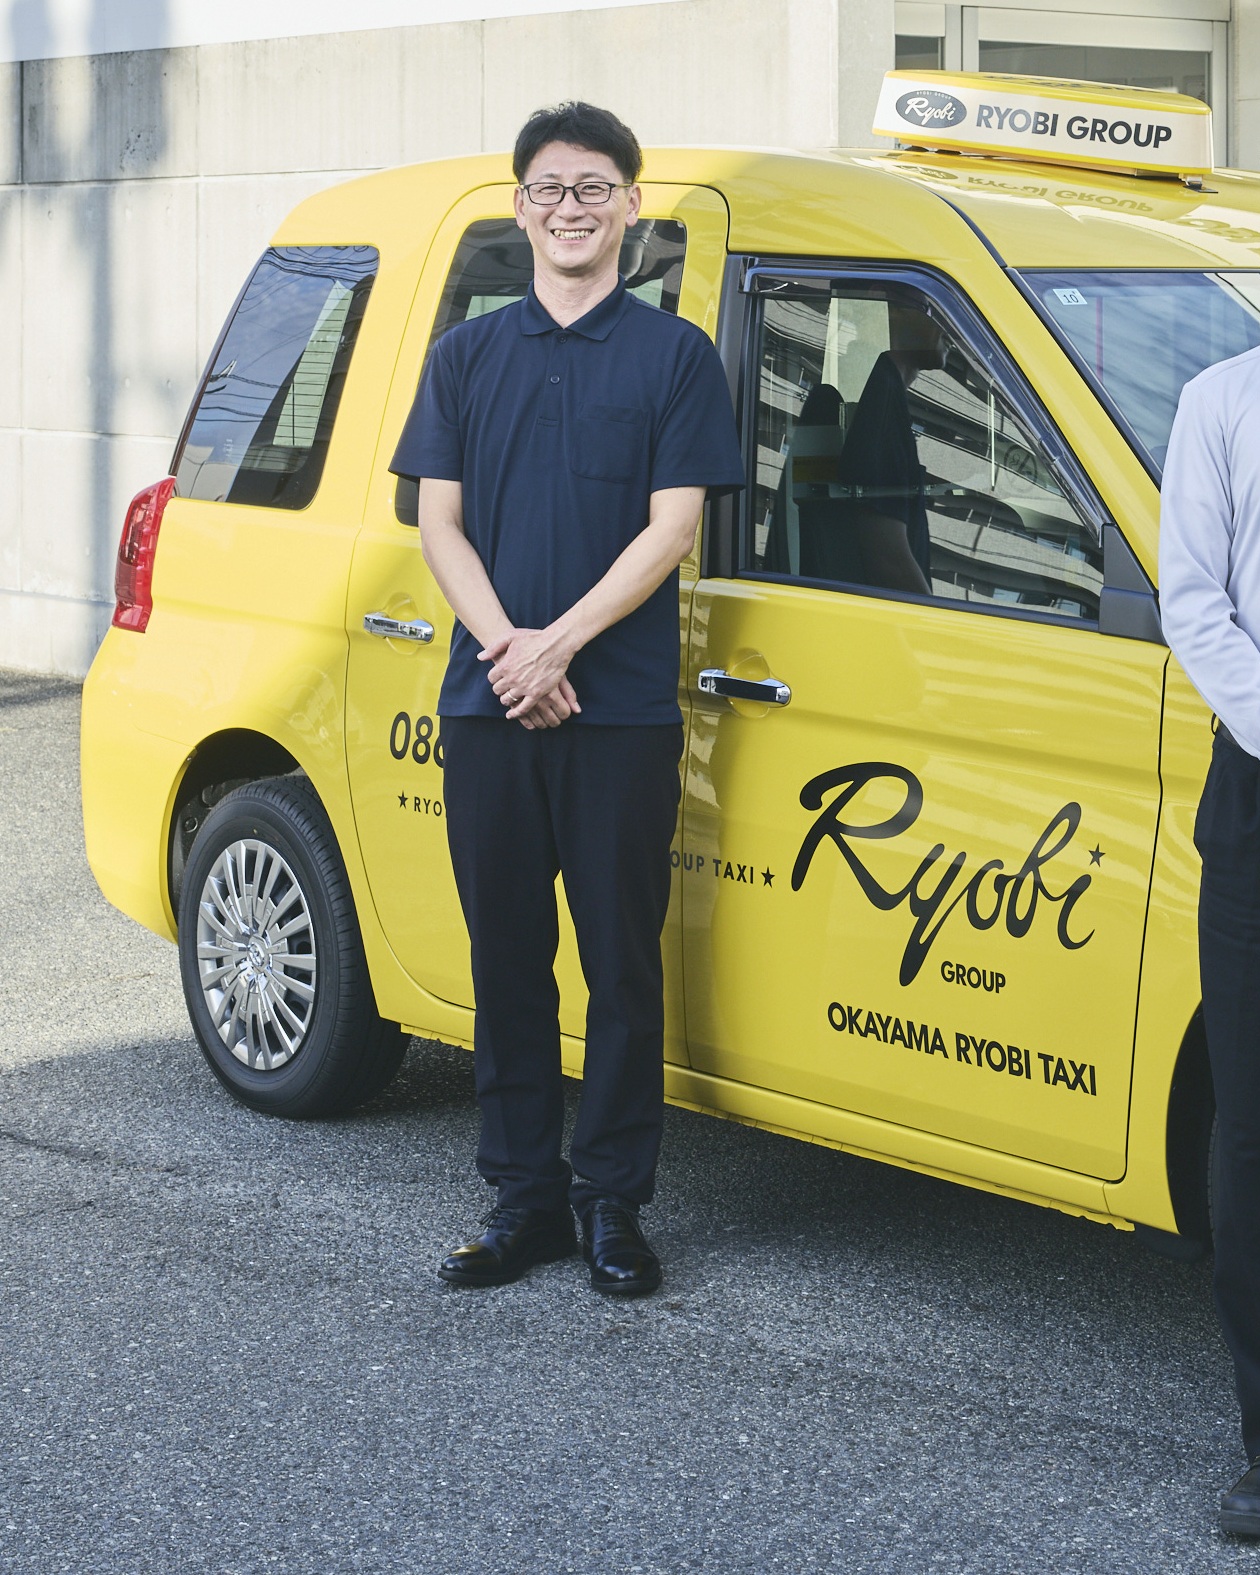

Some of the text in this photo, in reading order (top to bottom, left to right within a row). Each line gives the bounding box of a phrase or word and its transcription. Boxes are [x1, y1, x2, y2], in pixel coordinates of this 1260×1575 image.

[904, 97, 957, 125] Ryobi
[975, 104, 1172, 149] RYOBI GROUP
[1063, 294, 1079, 304] 10
[712, 858, 754, 884] TAXI
[791, 761, 1106, 987] Ryobi
[940, 960, 1006, 994] GROUP
[827, 1001, 1098, 1096] OKAYAMA RYOBI TAXI
